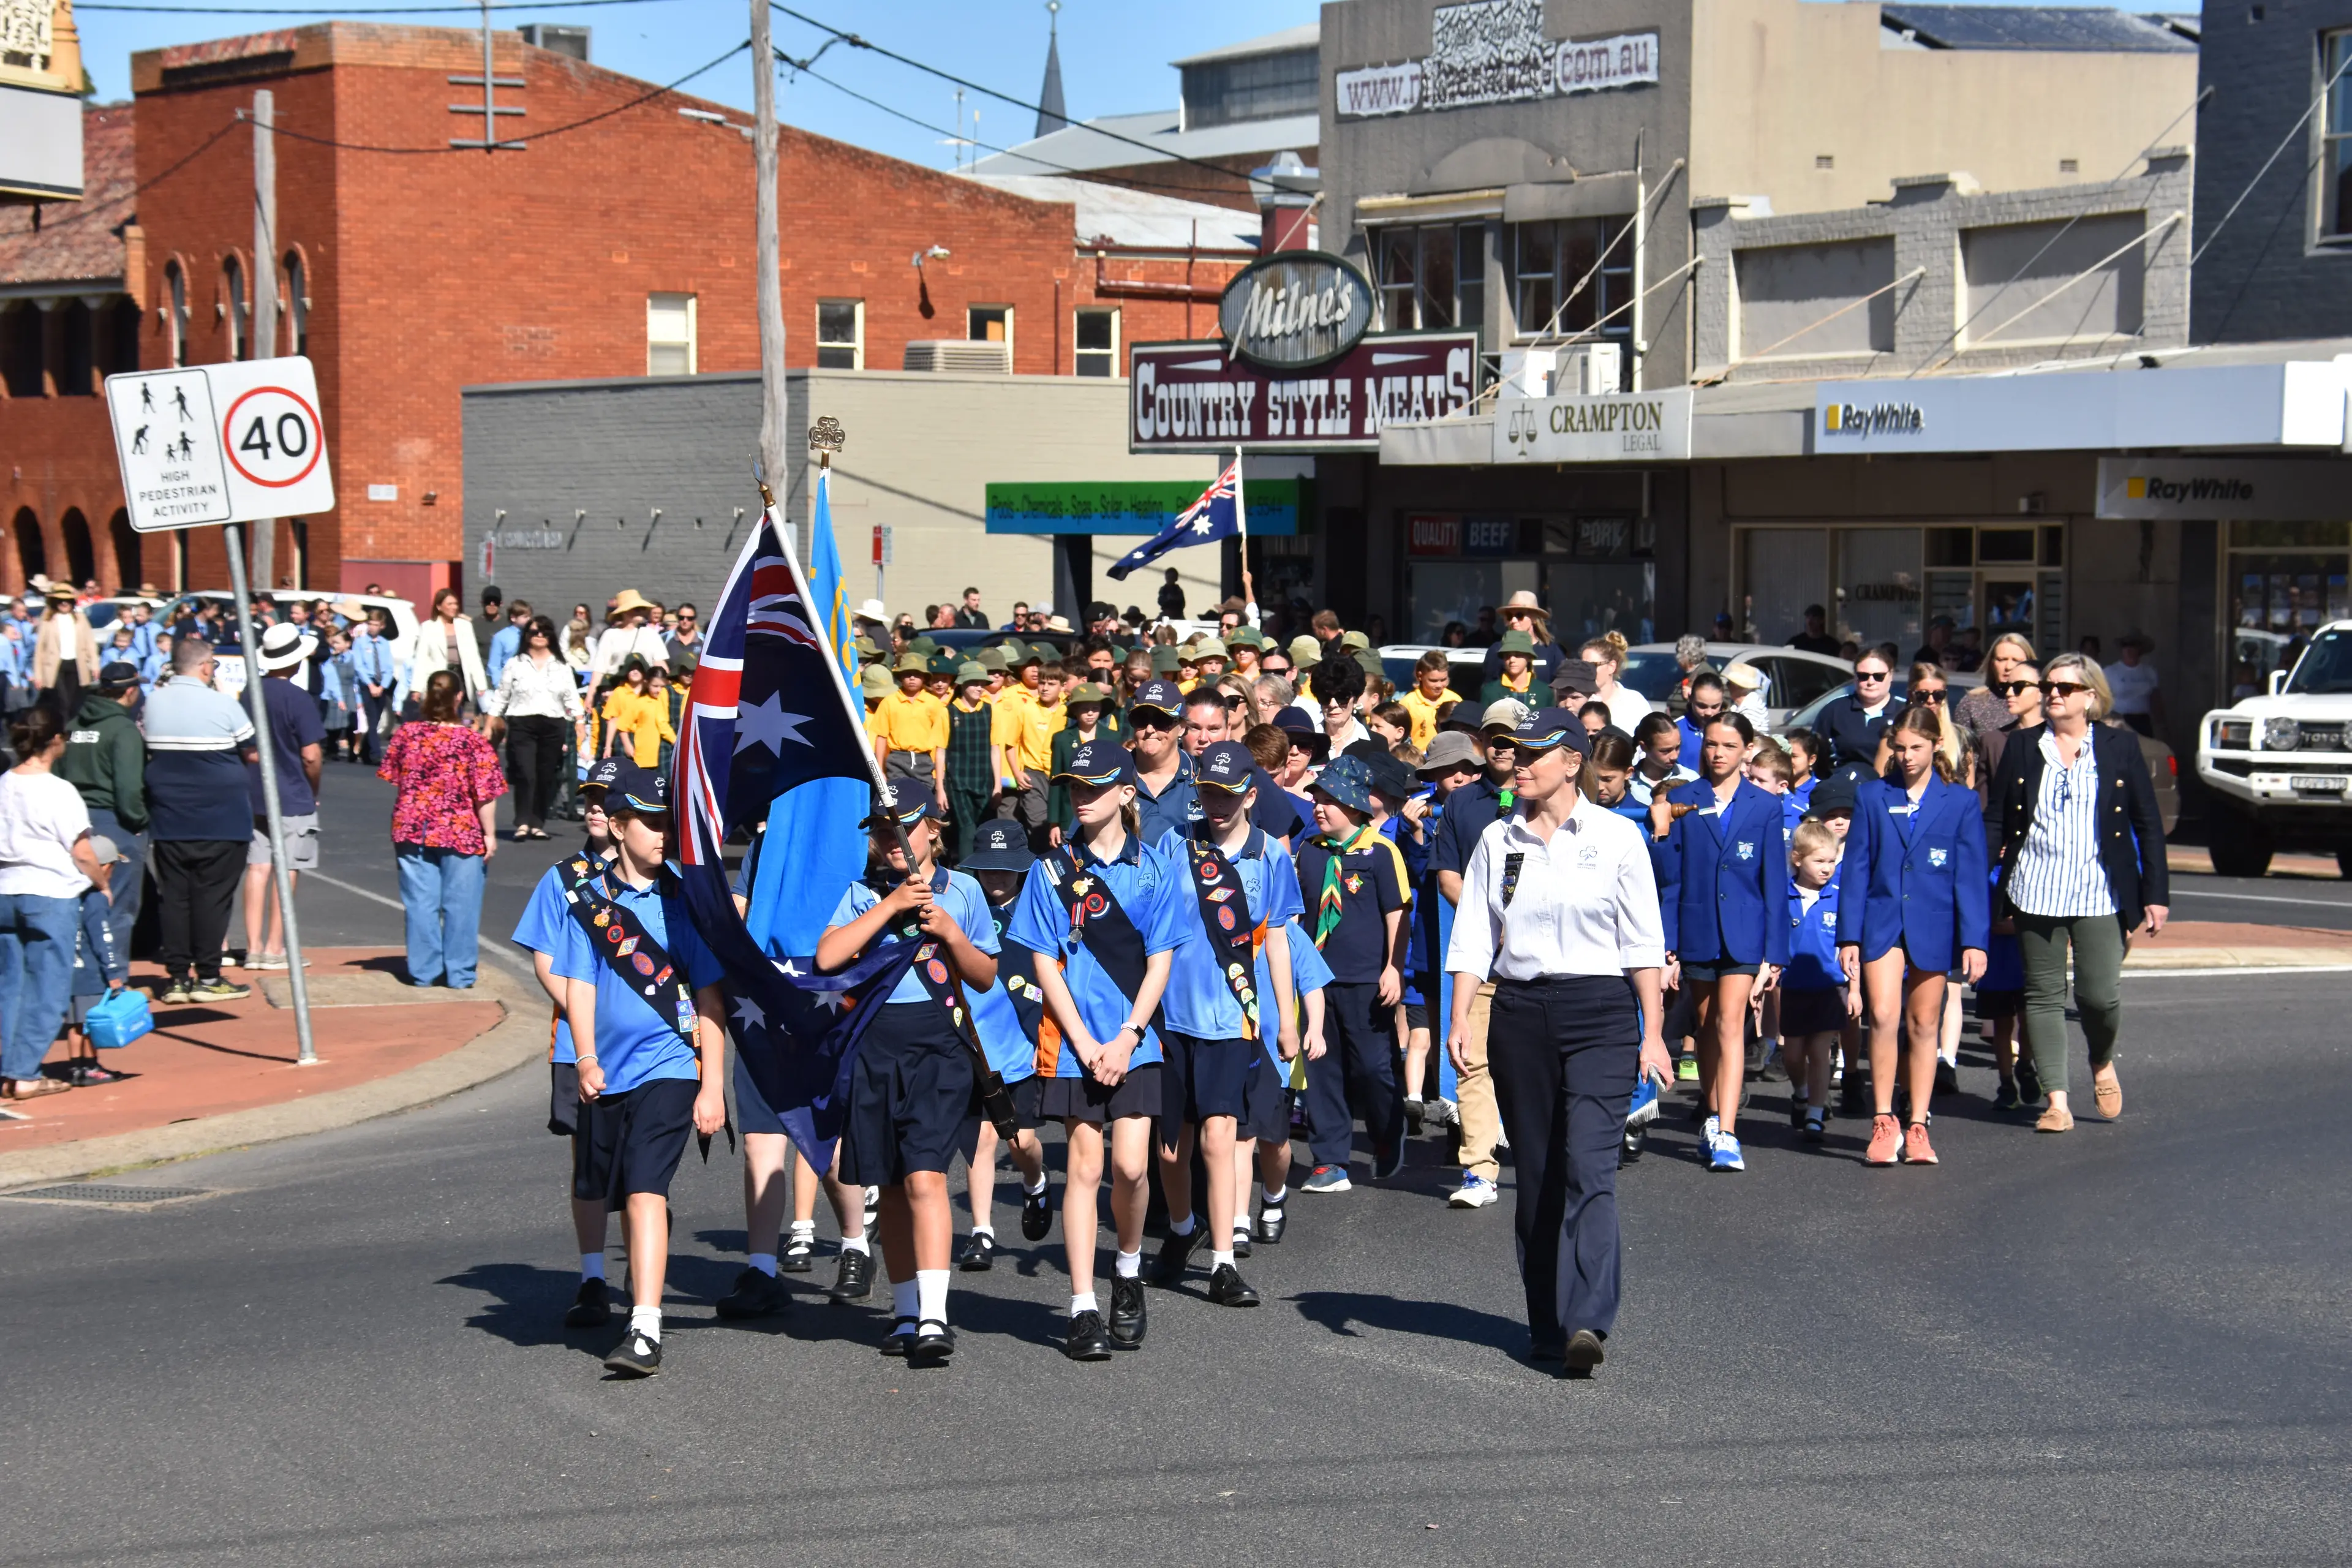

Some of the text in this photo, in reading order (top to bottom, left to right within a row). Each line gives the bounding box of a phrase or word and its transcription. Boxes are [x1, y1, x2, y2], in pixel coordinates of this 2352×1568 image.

[1229, 267, 1352, 363] Milne's
[1137, 347, 1470, 440] COUNTRY STYLE MEATS
[1550, 402, 1662, 434] CRAMPTON
[239, 412, 307, 461] 40
[1623, 434, 1662, 452] LEGAL
[161, 470, 190, 483] HIGH
[139, 484, 217, 502] PEDESTRIAN
[153, 502, 209, 518] ACTIVITY
[991, 494, 1015, 519] Pools
[1021, 493, 1063, 519] Chemicals
[1071, 494, 1092, 526] Spas
[1130, 493, 1164, 527] Heating
[1413, 520, 1459, 547] QUALITY
[1470, 521, 1510, 547] BEEF
[1580, 522, 1627, 548] PORK
[2304, 732, 2339, 742] TOYO
